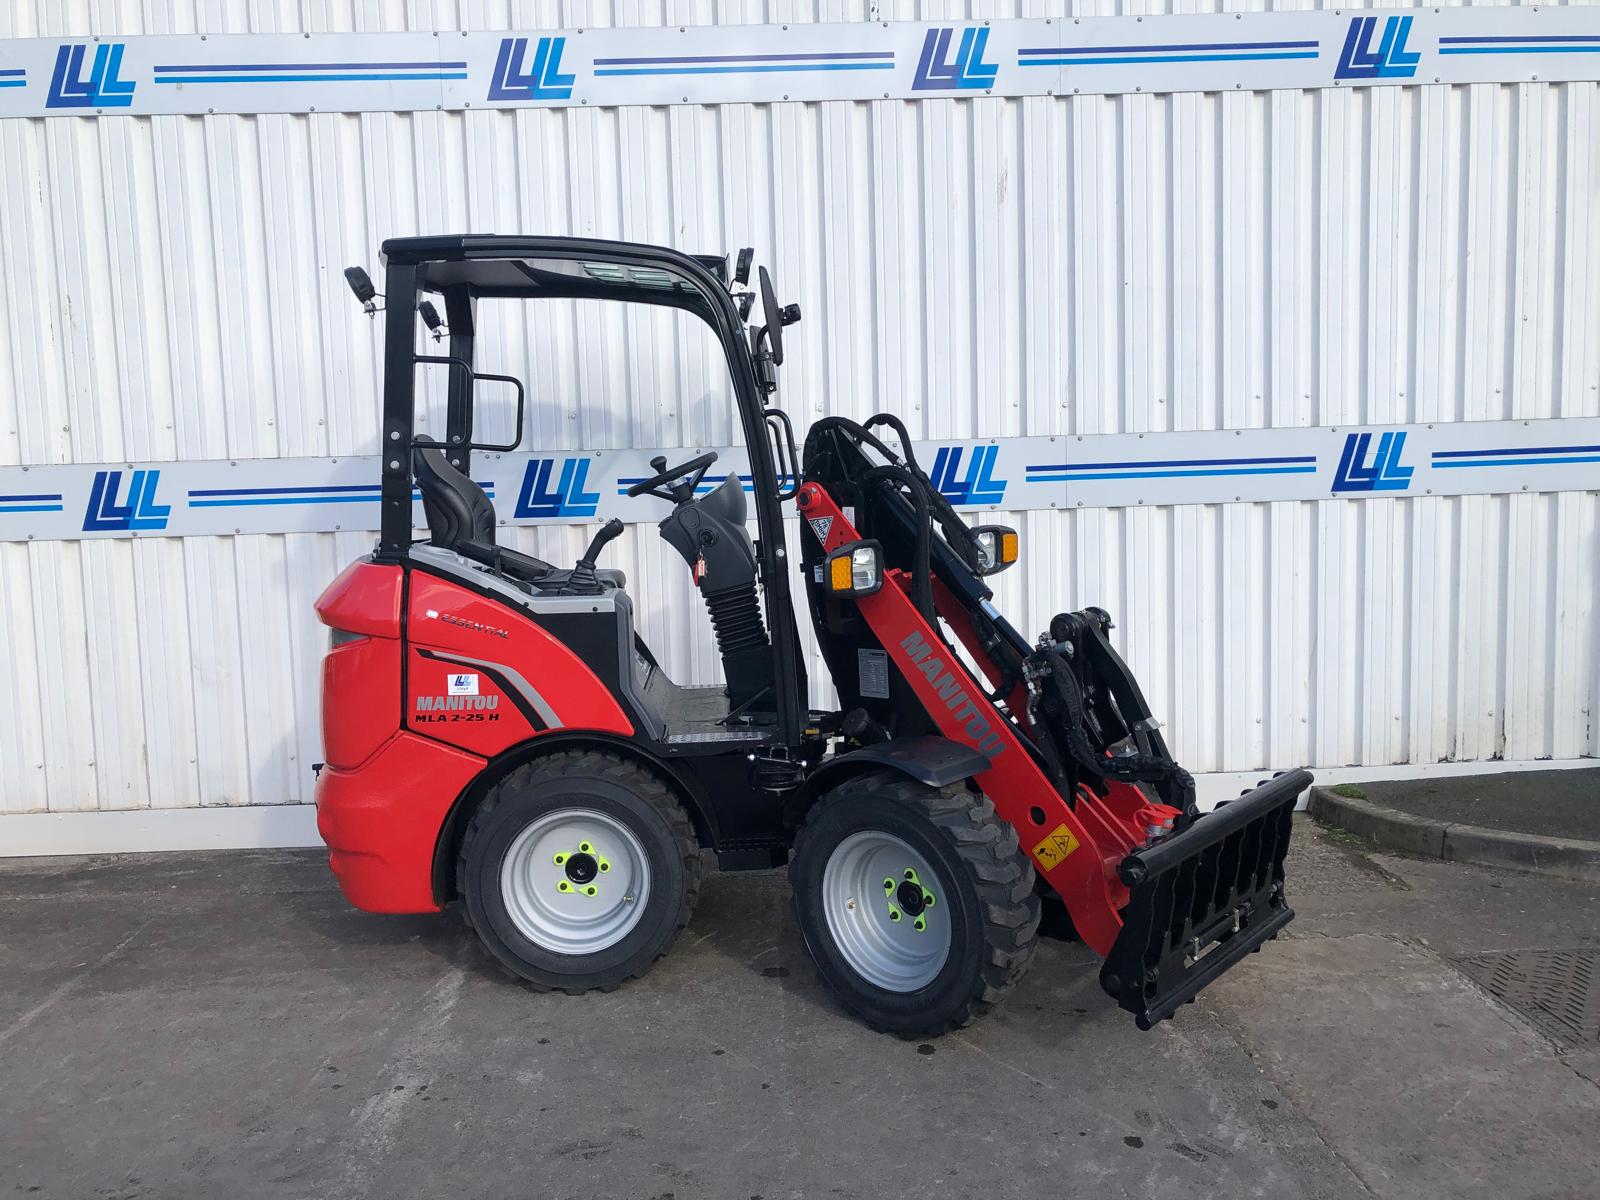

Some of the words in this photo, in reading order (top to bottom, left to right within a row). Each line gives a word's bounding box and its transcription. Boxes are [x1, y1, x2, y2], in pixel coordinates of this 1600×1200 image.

[441, 613, 509, 639] ESSENTIAL
[416, 695, 498, 711] MANITOU
[900, 630, 1006, 758] MANITOU
[415, 714, 447, 722] MLA
[451, 714, 484, 722] 2-25
